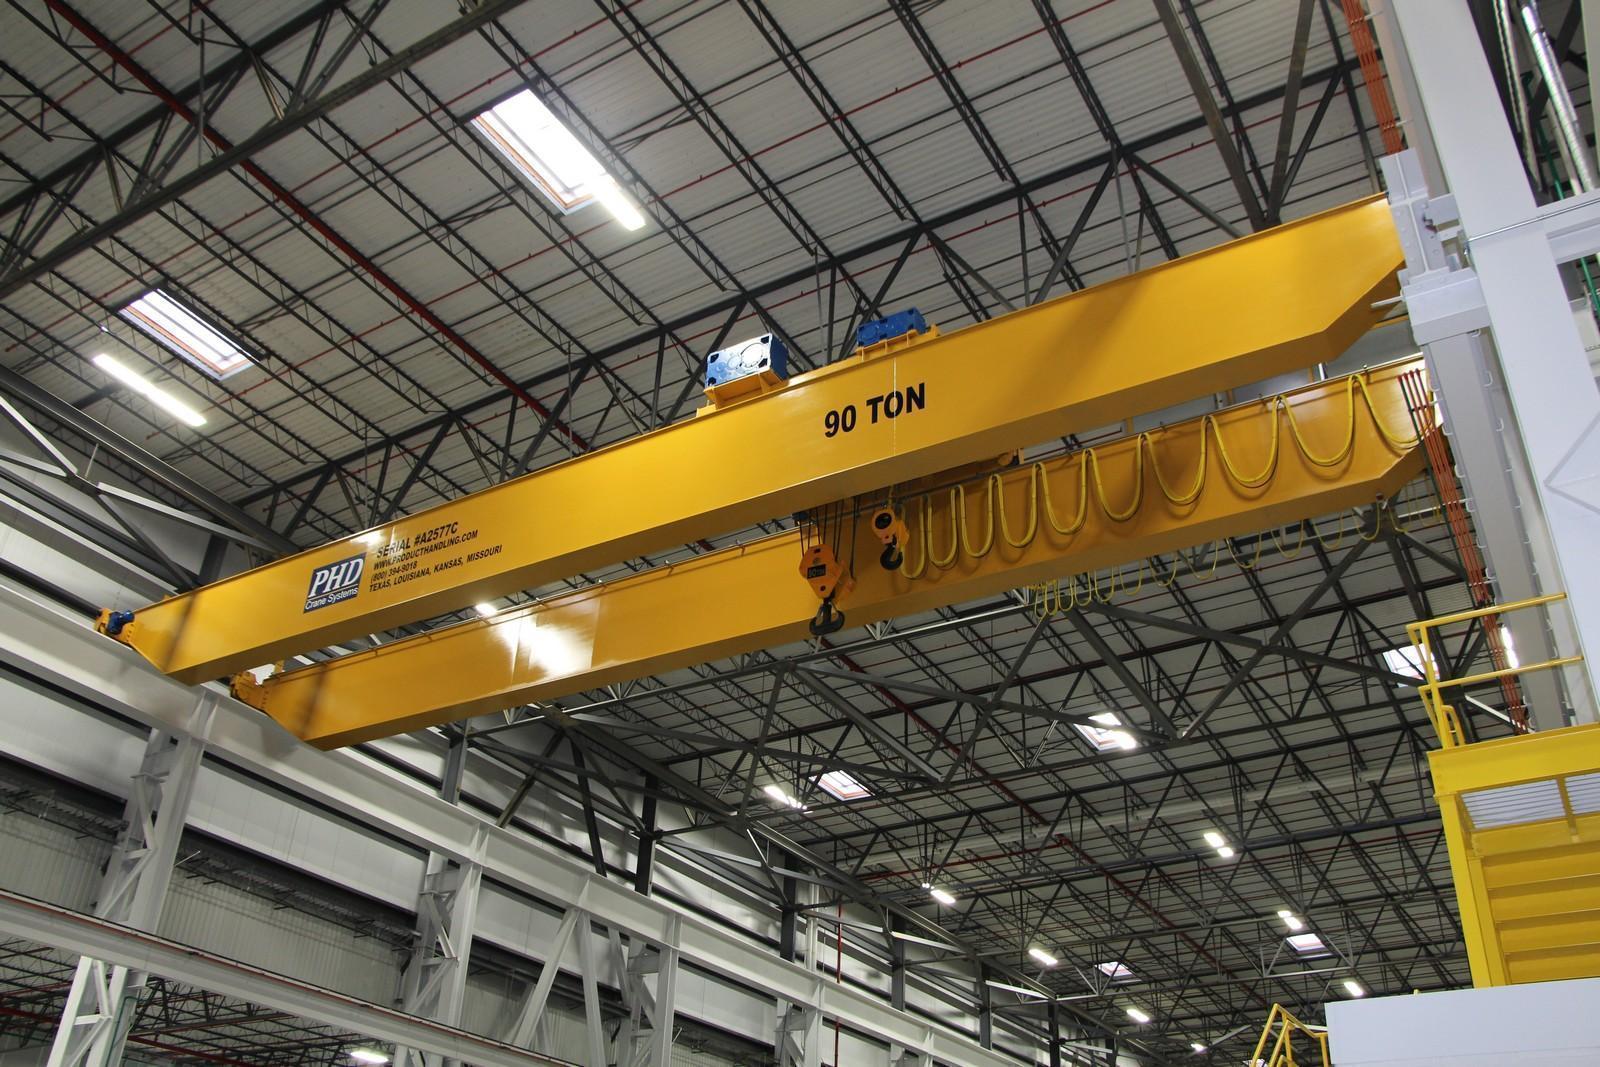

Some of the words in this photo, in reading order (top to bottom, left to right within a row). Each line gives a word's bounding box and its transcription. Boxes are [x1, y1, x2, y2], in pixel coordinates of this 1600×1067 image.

[825, 405, 857, 438] 90
[866, 382, 925, 424] TON
[374, 530, 478, 570] WWW.PRODUCTHANDLING.COM
[377, 538, 411, 558] SERIAL
[414, 521, 459, 546] #A2577C
[308, 558, 364, 598] PHD
[369, 578, 392, 592] TEXAS,
[394, 567, 431, 585] LOUISIANA,
[434, 557, 464, 572] KANSAS,
[467, 544, 503, 563] MISSOURI
[371, 570, 388, 583] (800)
[388, 560, 418, 577] 394-9018
[305, 598, 327, 610] Crane
[327, 587, 359, 604] Systems
